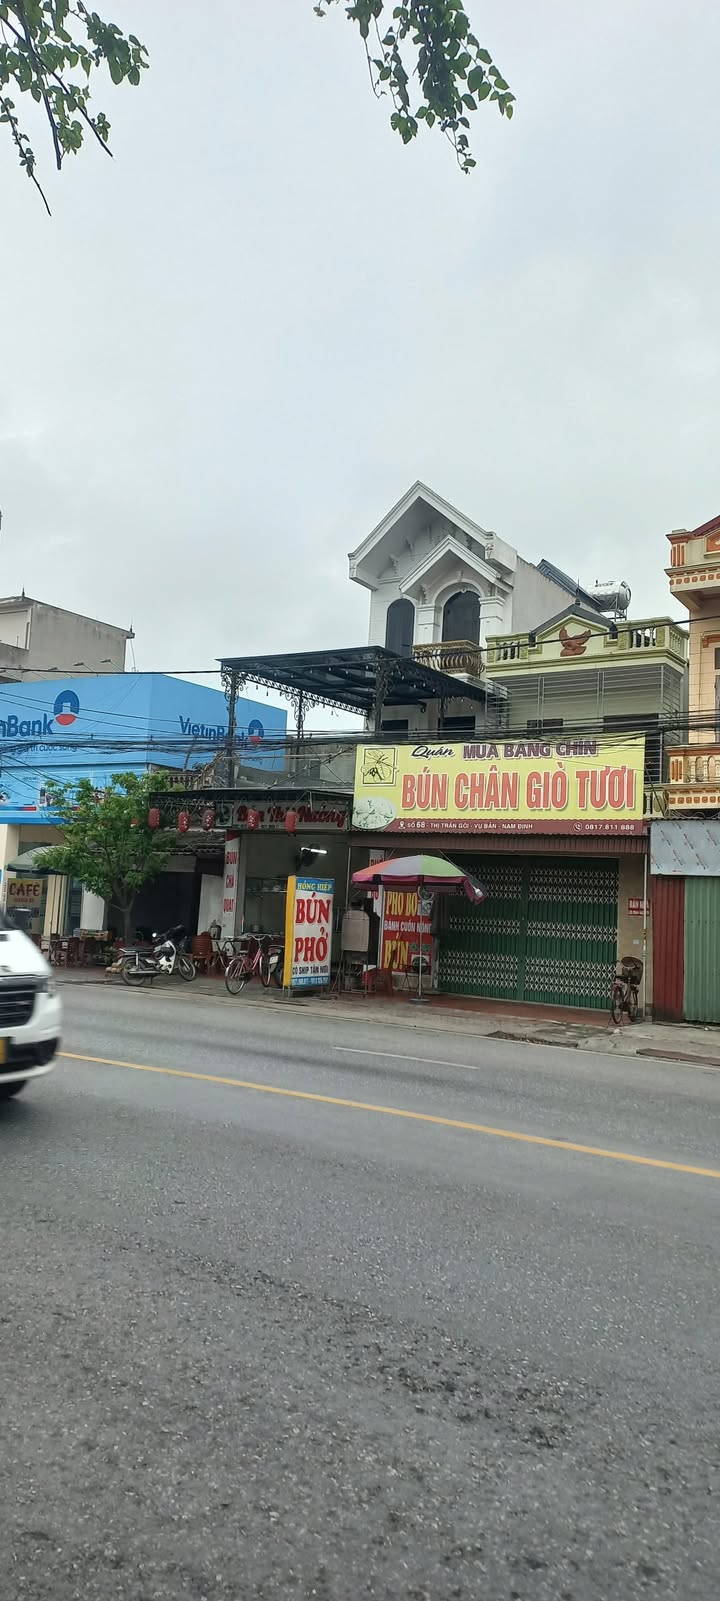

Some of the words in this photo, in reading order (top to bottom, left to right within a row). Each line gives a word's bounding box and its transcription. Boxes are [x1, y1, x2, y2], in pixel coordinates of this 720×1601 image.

[411, 745, 455, 757] Quán
[401, 767, 448, 809] BÚN
[454, 765, 519, 809] CHÂN
[526, 762, 567, 809] GIÒ
[576, 765, 635, 809] TƯƠI
[295, 892, 331, 924] BÚN
[293, 927, 329, 963] PHỞ
